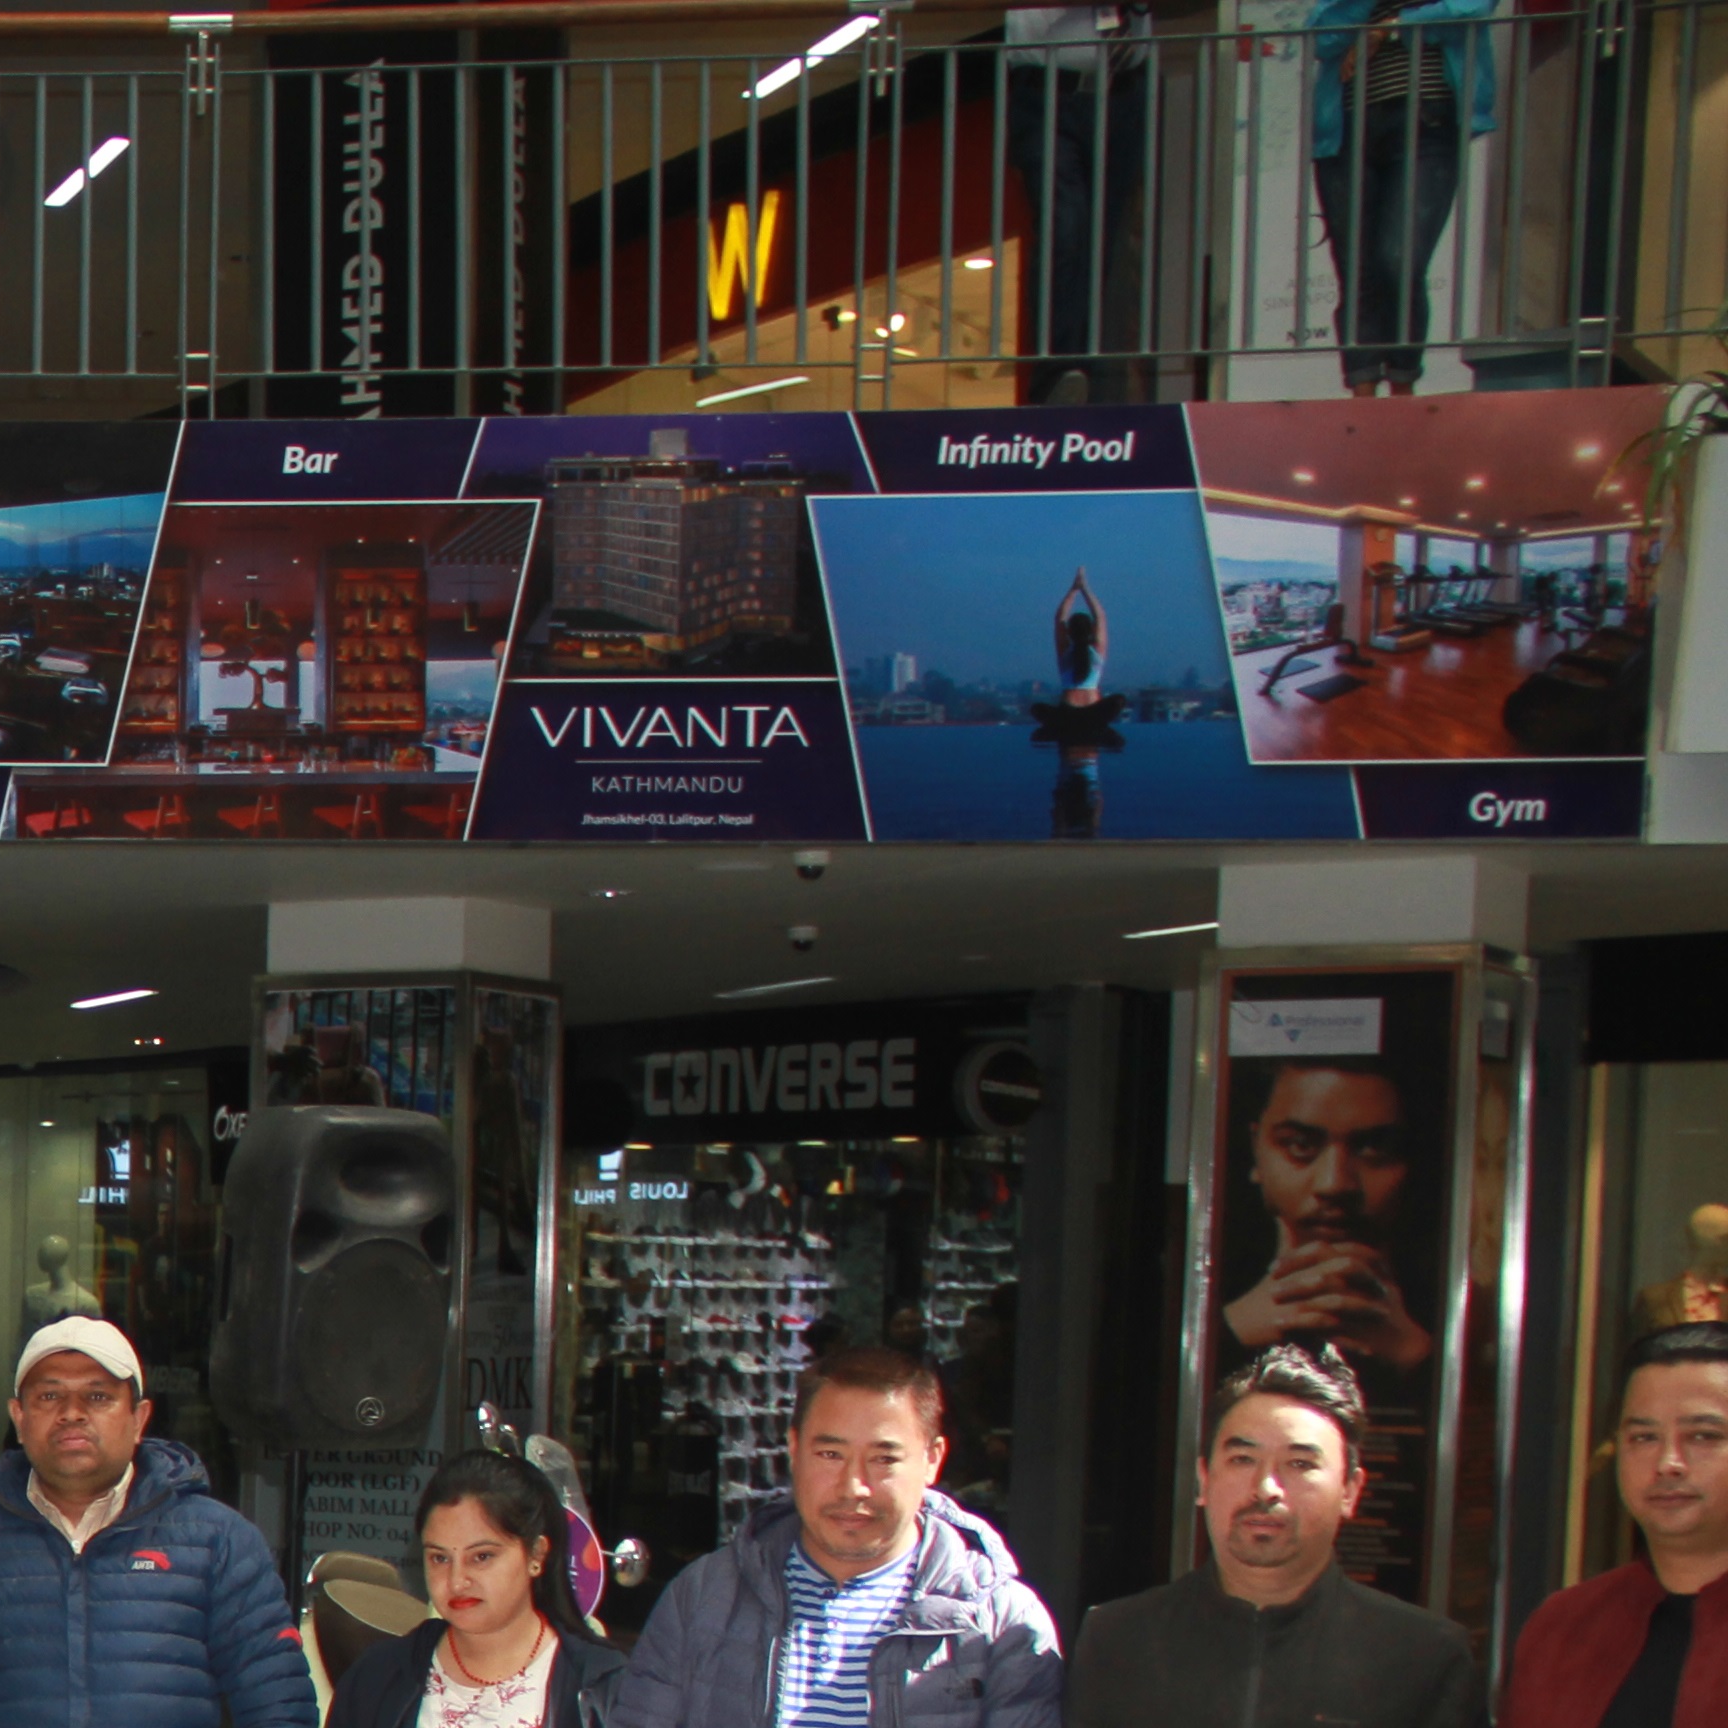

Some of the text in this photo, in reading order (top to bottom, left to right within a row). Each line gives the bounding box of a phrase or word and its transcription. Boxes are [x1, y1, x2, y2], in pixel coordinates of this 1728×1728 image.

[282, 447, 338, 475] Bar
[938, 432, 1134, 470] Infinity Pool
[530, 705, 809, 748] VIVANTA
[591, 775, 744, 794] KATHMANDU
[718, 813, 753, 827] Nepal
[1468, 792, 1547, 826] Gym
[644, 1038, 916, 1116] CONVERSE
[465, 1356, 533, 1412] DMK
[362, 1473, 421, 1494] (LGF)
[304, 1496, 354, 1515] ABIM
[304, 1520, 342, 1539] HOP
